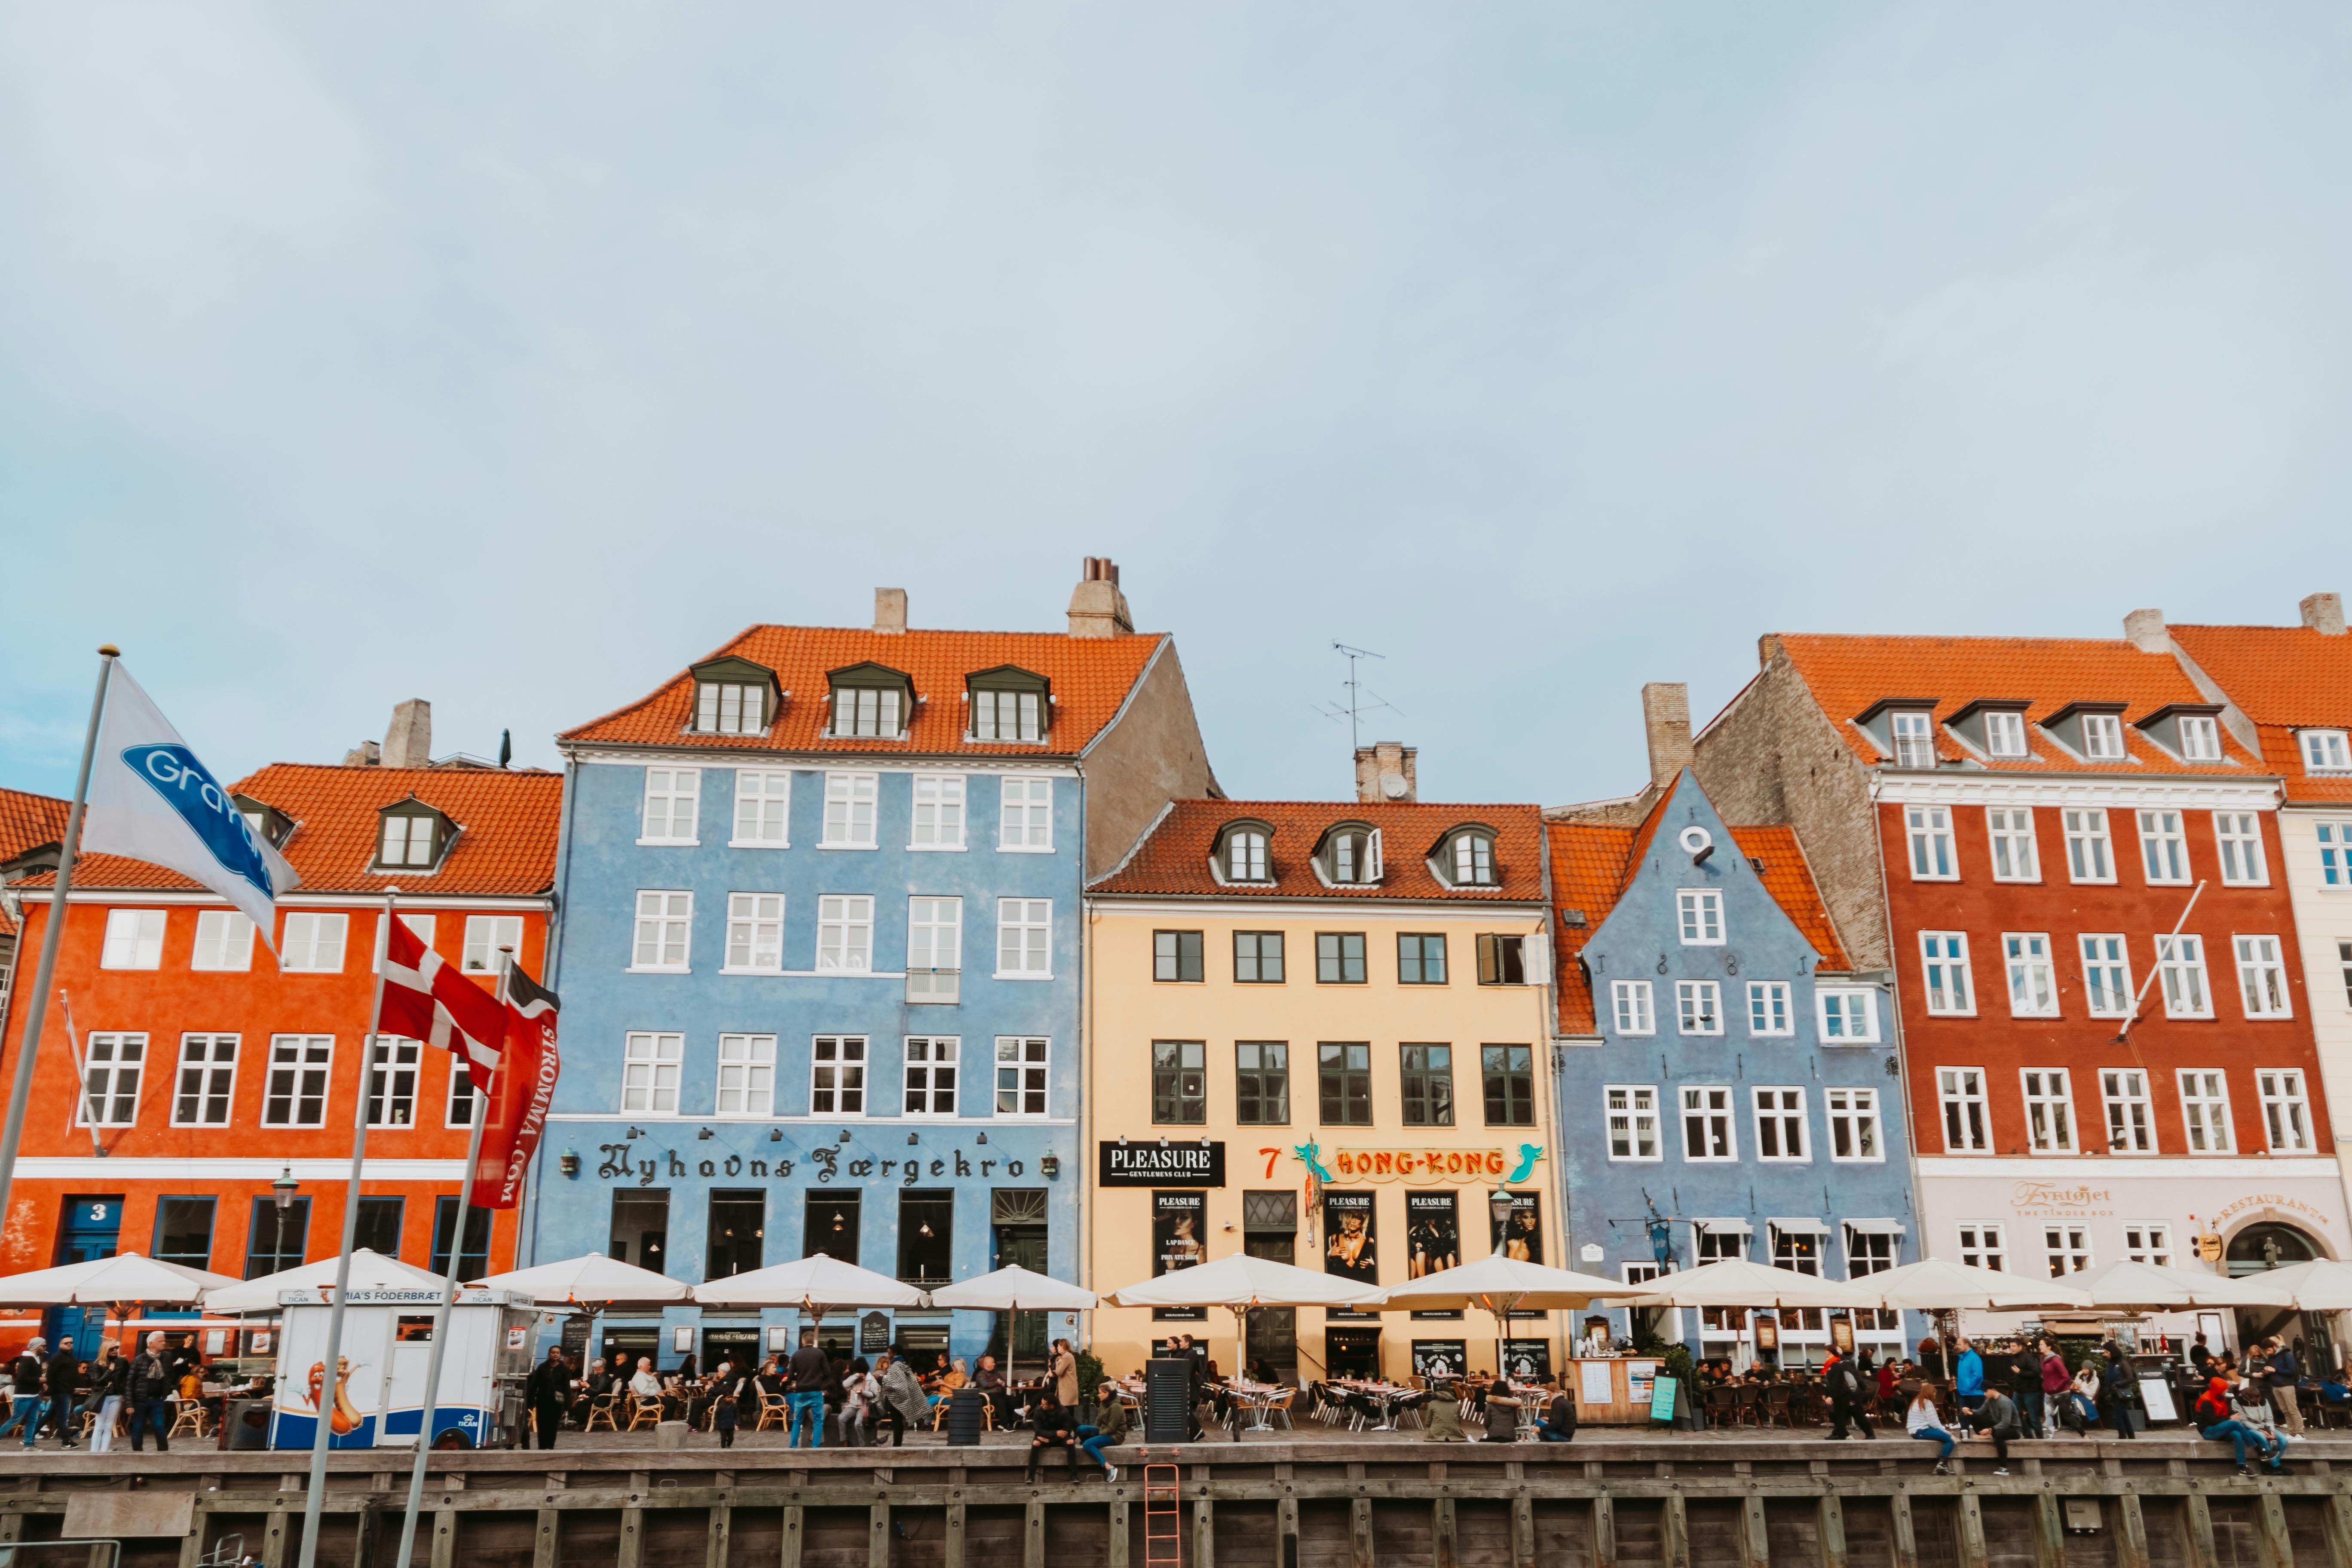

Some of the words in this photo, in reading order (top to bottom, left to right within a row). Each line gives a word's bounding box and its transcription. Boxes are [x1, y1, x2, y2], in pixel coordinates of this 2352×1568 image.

[1111, 1150, 1210, 1168] PLEASURE
[1259, 1148, 1282, 1179] 7
[1337, 1152, 1504, 1174] HONG-KONG
[1159, 1197, 1200, 1206] PLEASURE
[1329, 1197, 1369, 1206] PLEASURE
[2220, 1194, 2319, 1220] RESTAURANT
[90, 1204, 106, 1221] 3
[374, 1292, 442, 1300] FODERBRÆT
